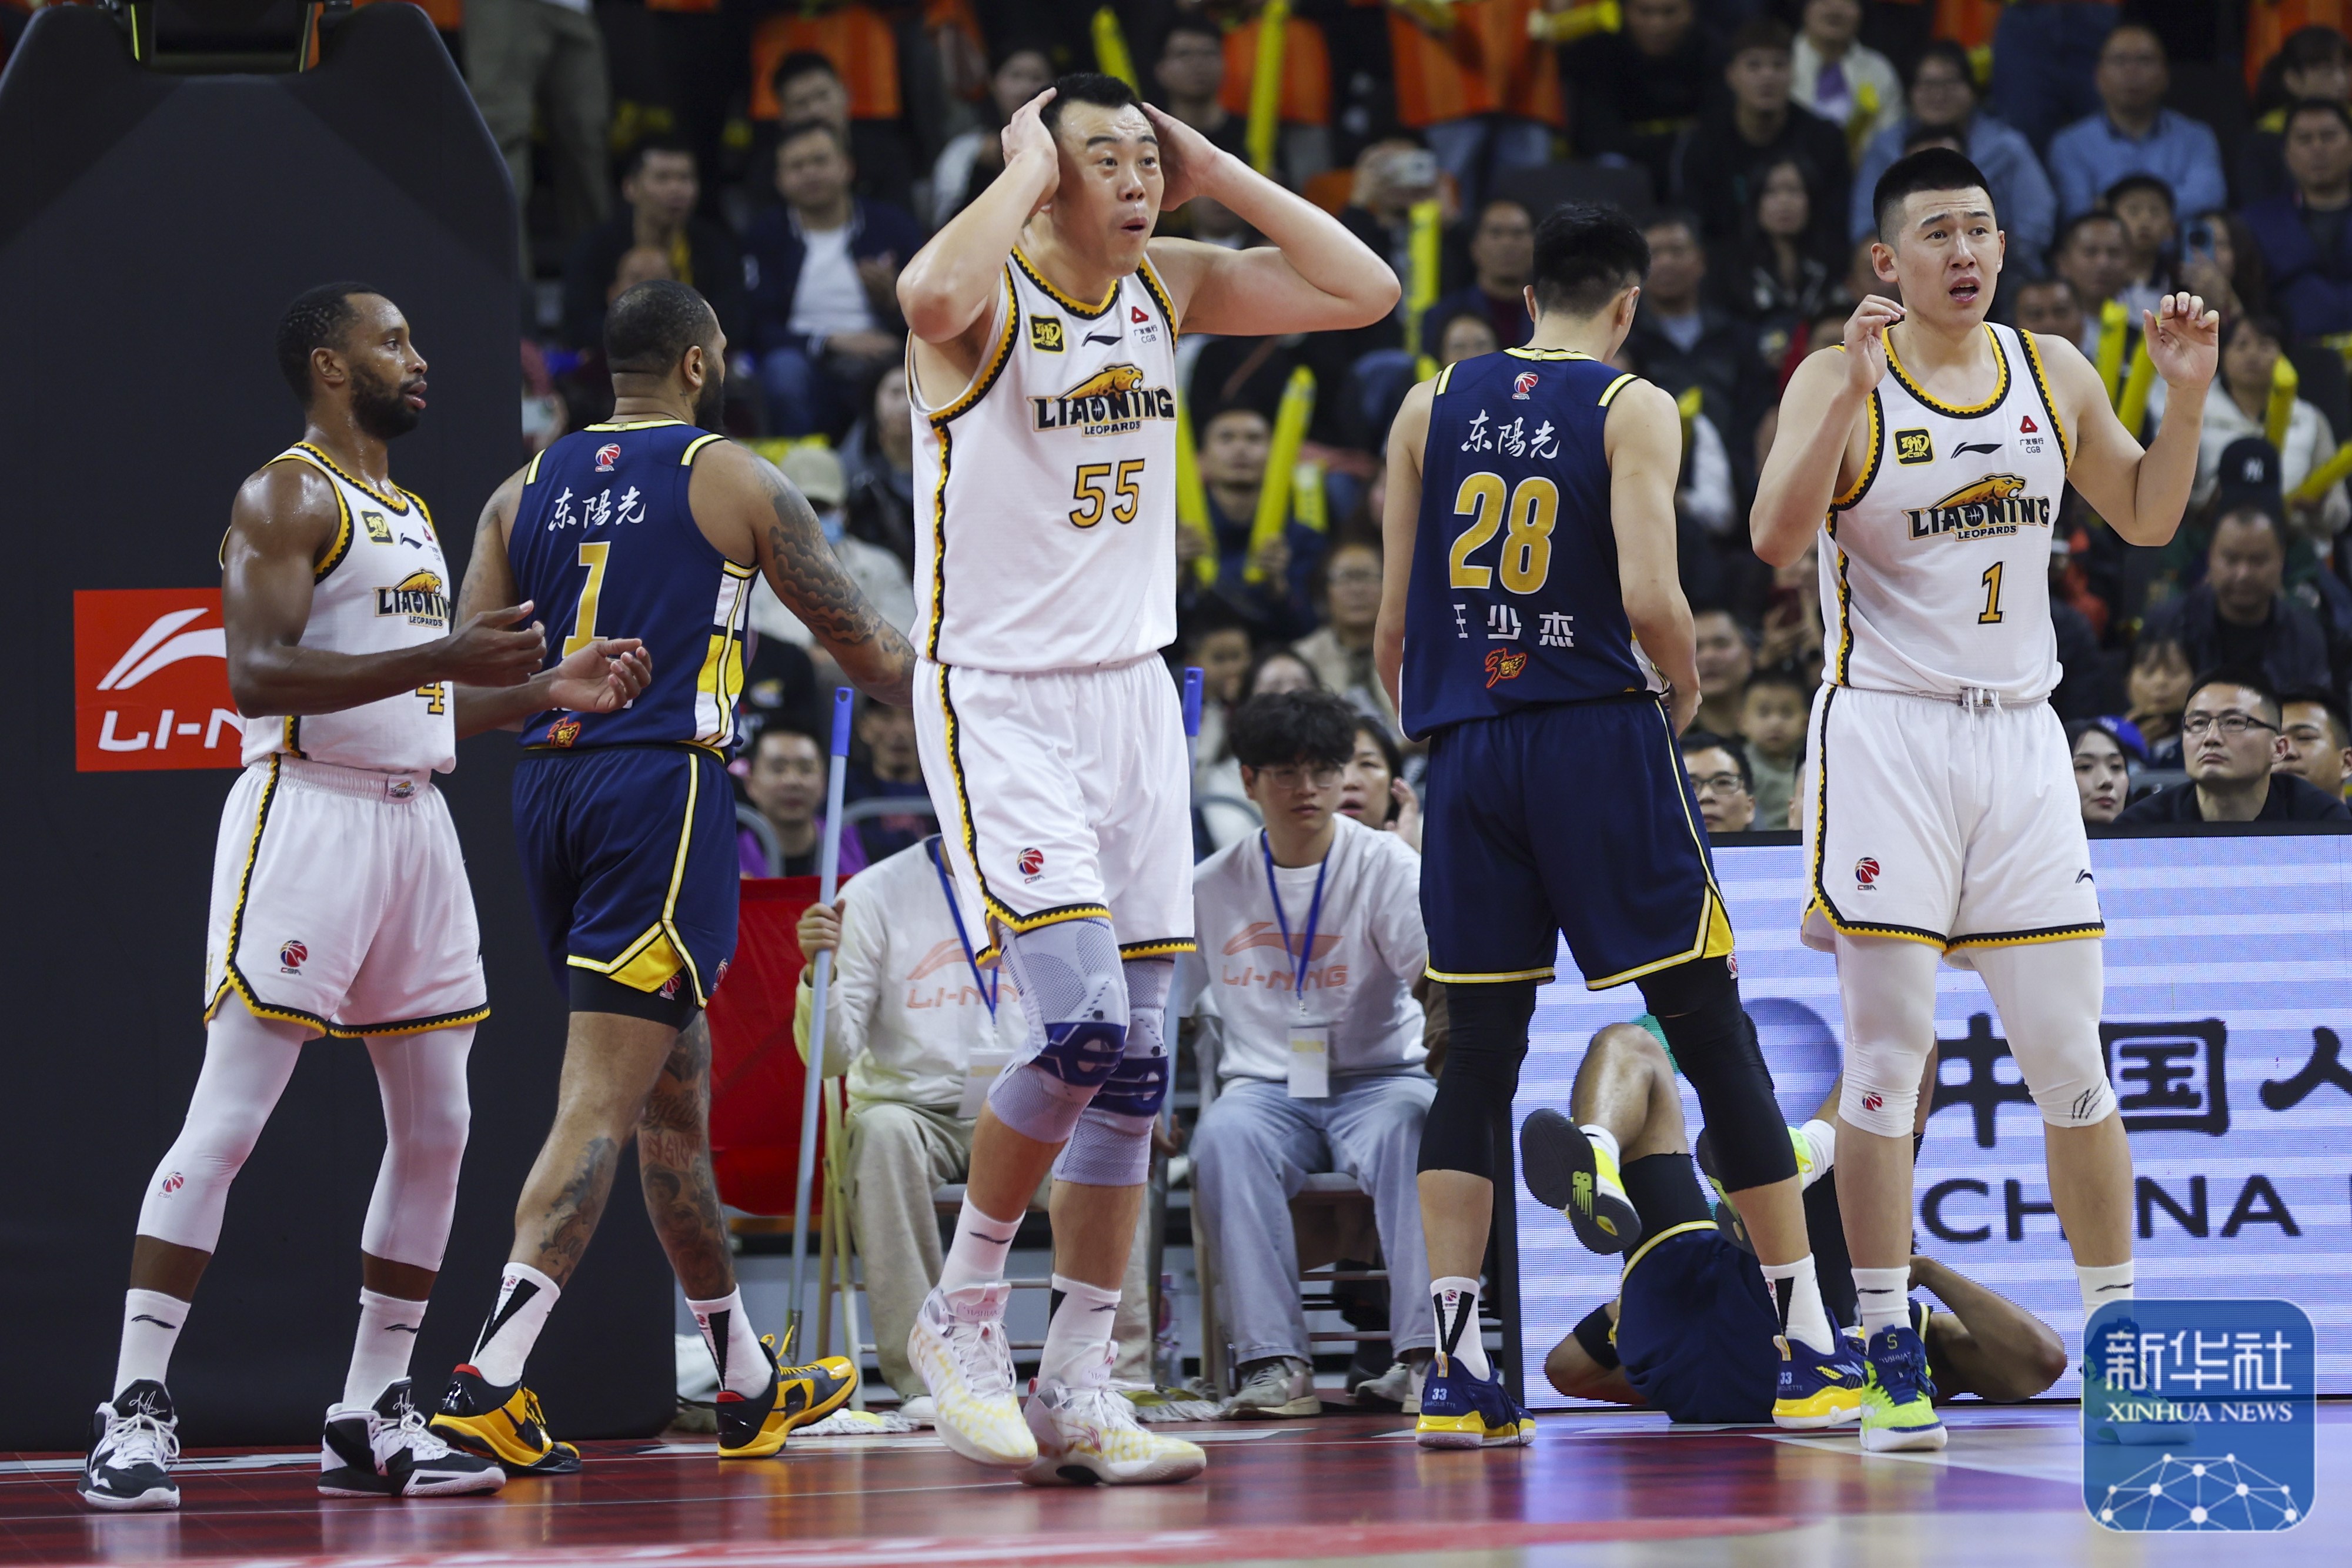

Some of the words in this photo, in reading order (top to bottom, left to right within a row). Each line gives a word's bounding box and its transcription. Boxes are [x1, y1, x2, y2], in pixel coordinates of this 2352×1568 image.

[1141, 334, 1157, 344] CGB
[1035, 387, 1175, 429] LIAONING
[1084, 420, 1141, 435] LEOPARDS
[2019, 437, 2044, 446] 广发银行
[1069, 459, 1145, 529] 55
[1908, 497, 2050, 538] LIAONING
[1449, 471, 1559, 595] 28
[1958, 525, 2017, 540] LEOPARDS
[562, 541, 611, 659] 1
[1978, 561, 2003, 624] 1
[409, 616, 443, 627] LEOPARDS
[1919, 1175, 2302, 1243] CHNA
[1780, 1371, 1793, 1385] 33
[1432, 1388, 1448, 1400] 33
